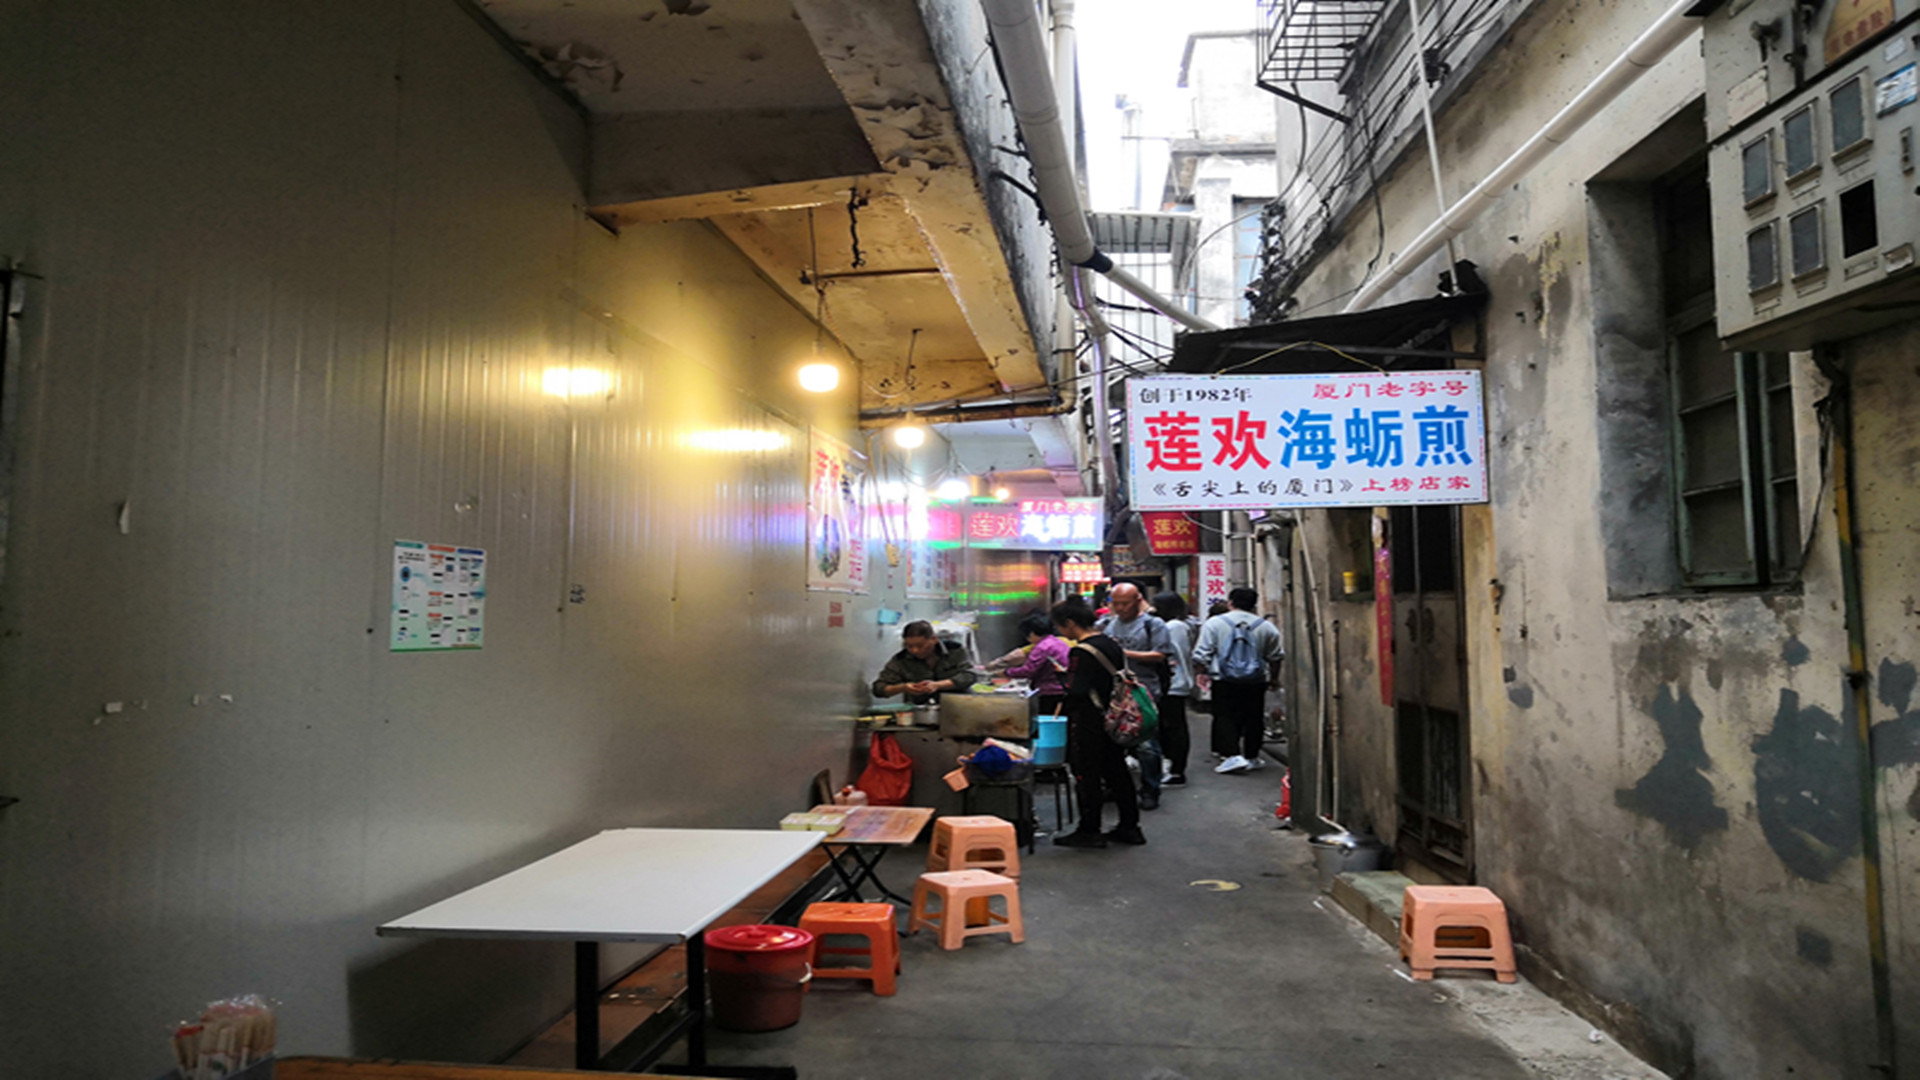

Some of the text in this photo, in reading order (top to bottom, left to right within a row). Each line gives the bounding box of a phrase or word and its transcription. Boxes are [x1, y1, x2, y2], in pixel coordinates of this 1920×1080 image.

[1139, 386, 1254, 404] 创于1982年
[1312, 379, 1470, 400] 厦门老字号
[1143, 403, 1475, 473] 莲欢海蛎煎
[1152, 518, 1193, 536] 莲欢
